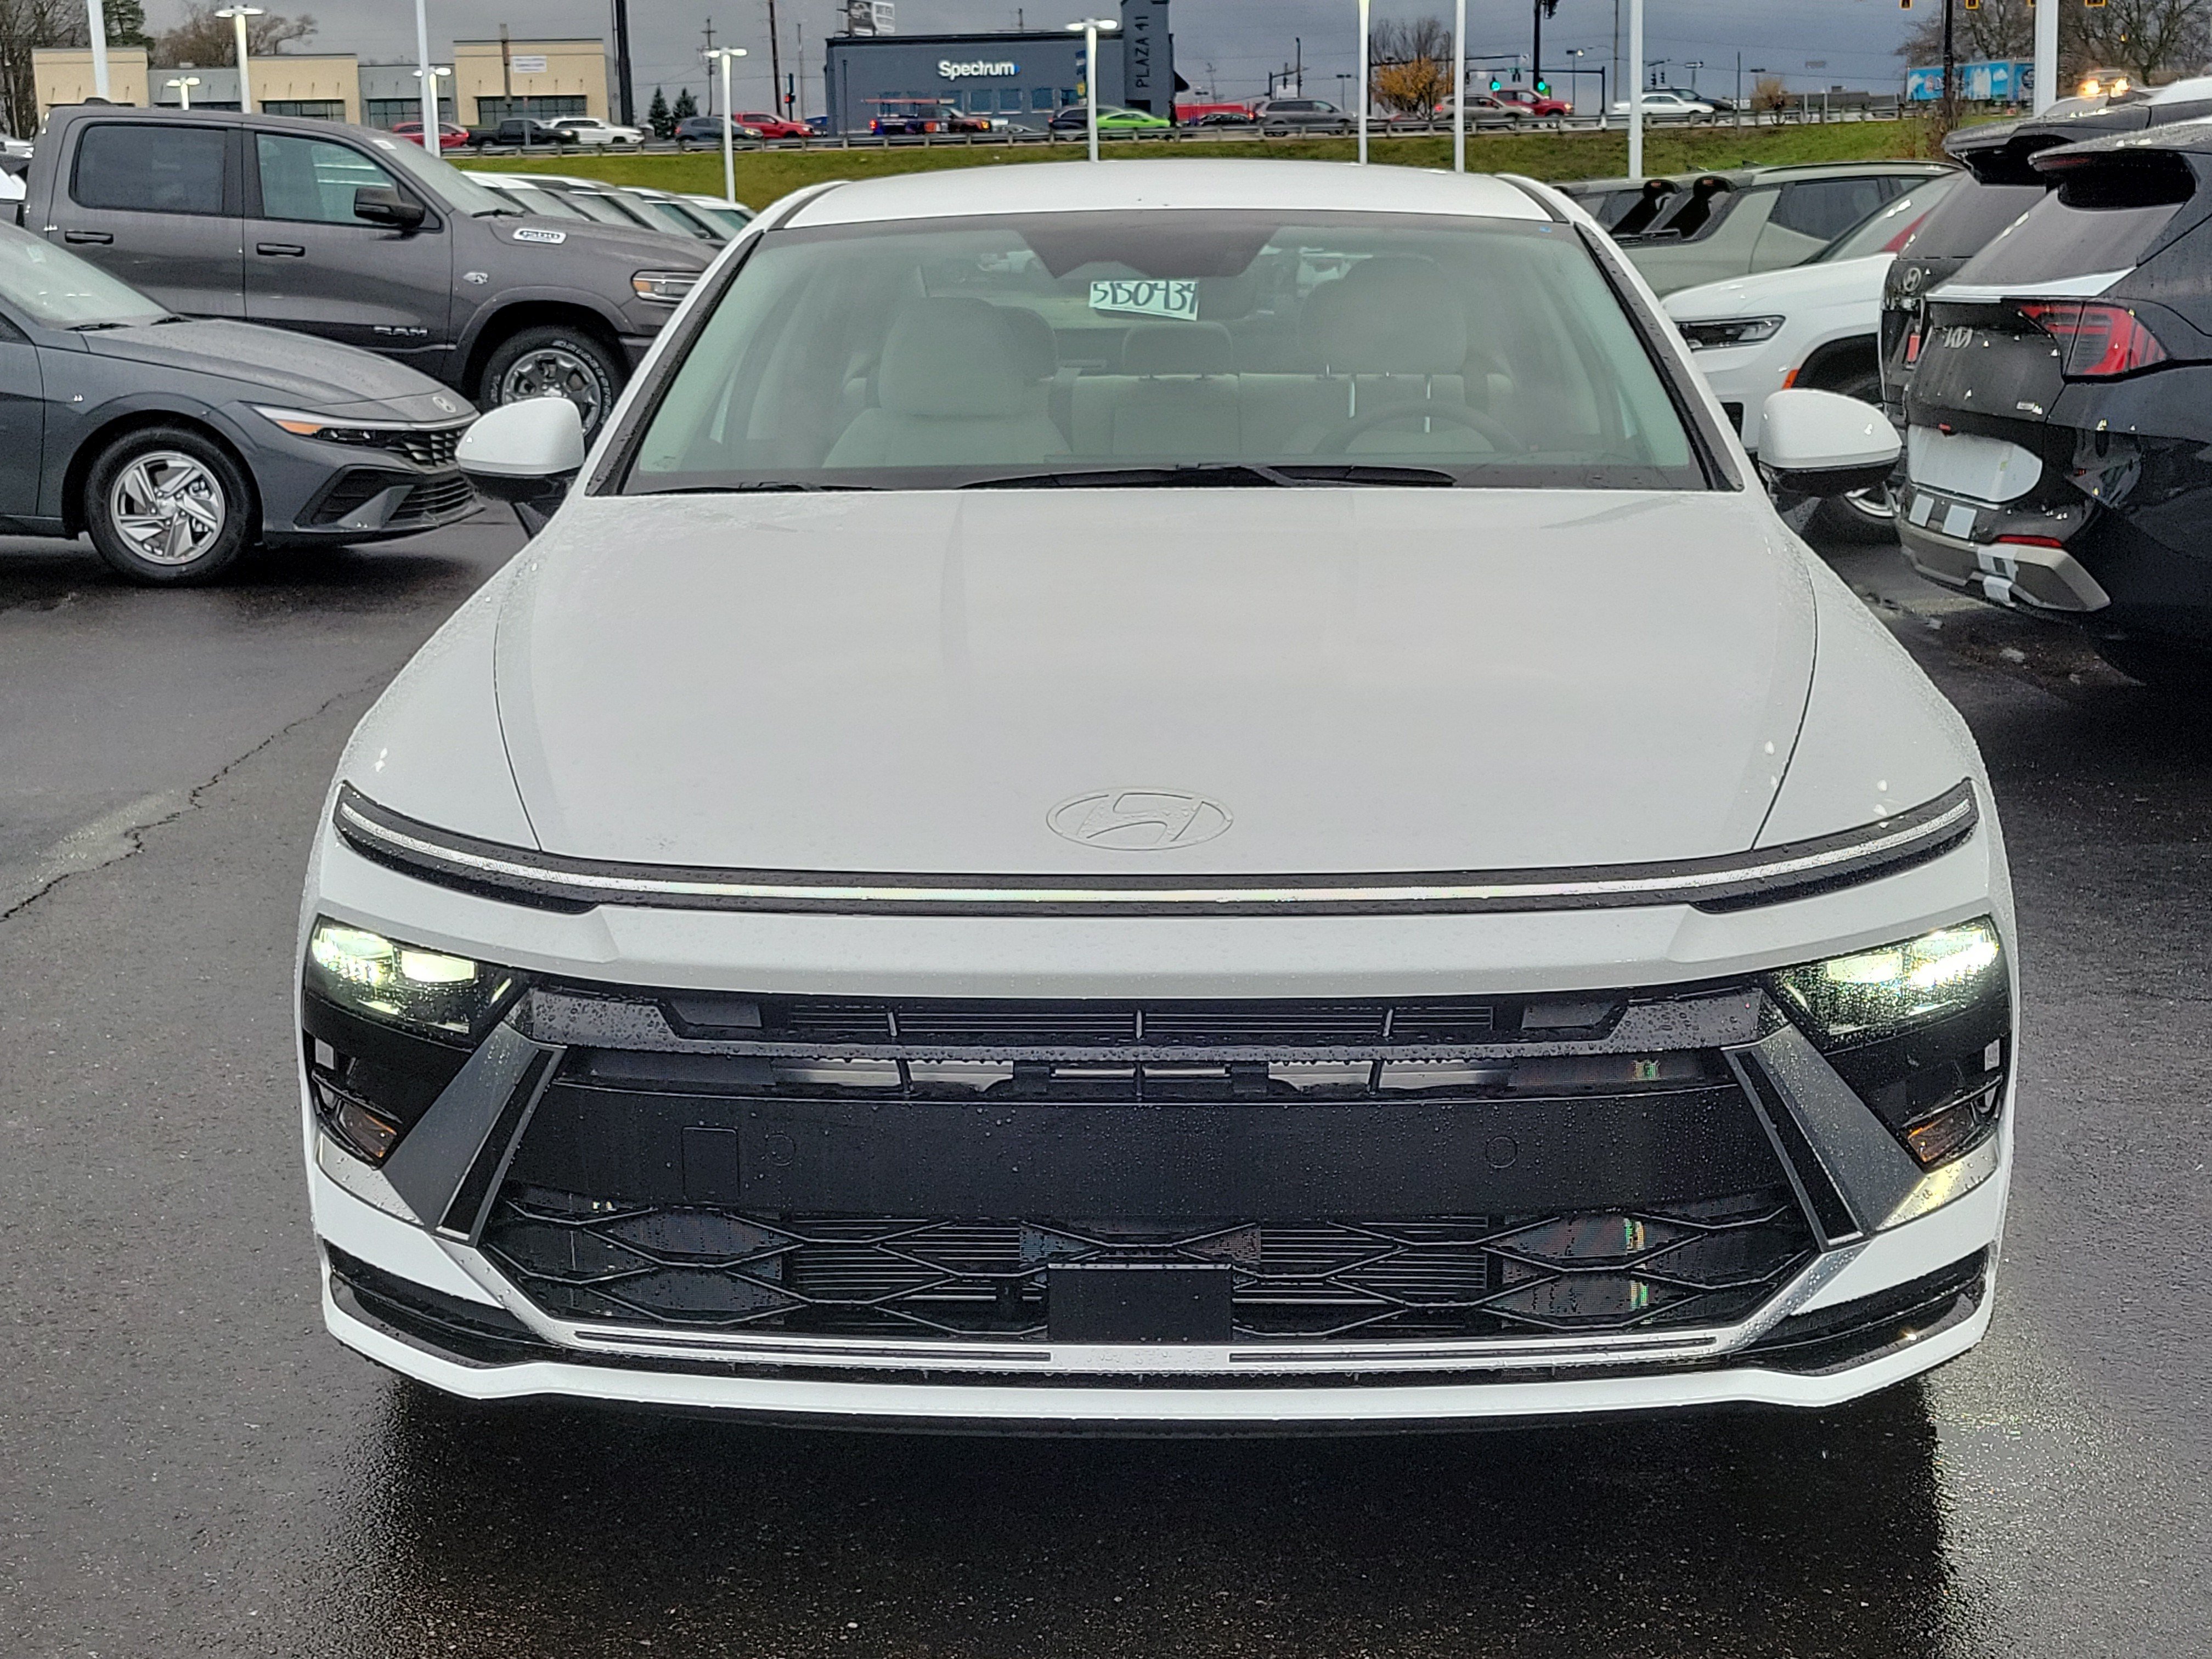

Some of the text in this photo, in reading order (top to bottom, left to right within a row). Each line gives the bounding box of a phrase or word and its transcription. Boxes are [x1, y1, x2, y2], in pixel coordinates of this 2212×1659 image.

[938, 60, 1016, 81] Spectrum
[1135, 16, 1150, 88] PLAZA 41
